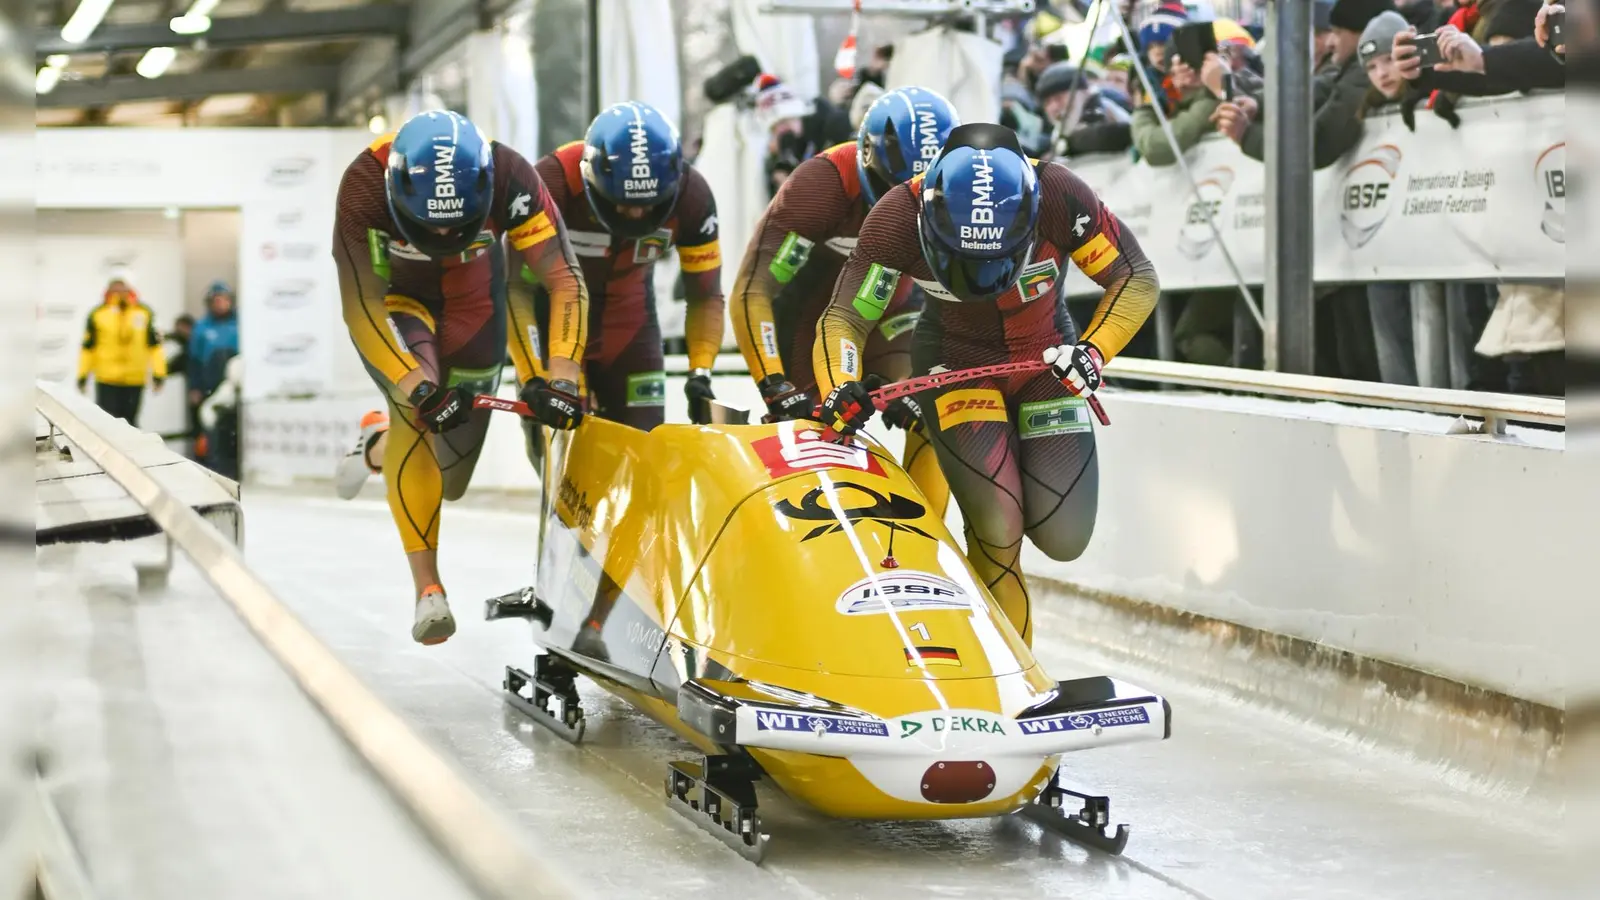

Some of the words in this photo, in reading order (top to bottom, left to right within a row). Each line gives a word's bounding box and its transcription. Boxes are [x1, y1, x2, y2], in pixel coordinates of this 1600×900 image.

[916, 111, 940, 159] BMW
[629, 127, 651, 178] BMW
[433, 145, 456, 198] BMW
[623, 178, 659, 191] BMW
[971, 162, 994, 224] BMW
[427, 198, 465, 211] BMW
[1344, 183, 1390, 211] IBSF
[428, 210, 464, 219] helmets
[960, 226, 1005, 240] BMW
[961, 239, 1002, 250] helmets
[1078, 355, 1098, 384] SEIZ
[550, 398, 576, 416] SEIZ
[781, 393, 807, 409] SEIZ
[901, 396, 923, 418] SEIZ
[944, 399, 1000, 414] DHL
[436, 400, 459, 423] SEIZ
[863, 584, 956, 599] IBSF
[908, 621, 932, 641] 1
[759, 711, 803, 730] WT
[1097, 708, 1142, 719] ENERGIE
[1098, 713, 1146, 726] SYSTEME
[837, 719, 882, 728] ENERGIE
[838, 725, 884, 735] SYSTEME
[932, 716, 1006, 736] DEKRA
[1022, 717, 1065, 734] WT
